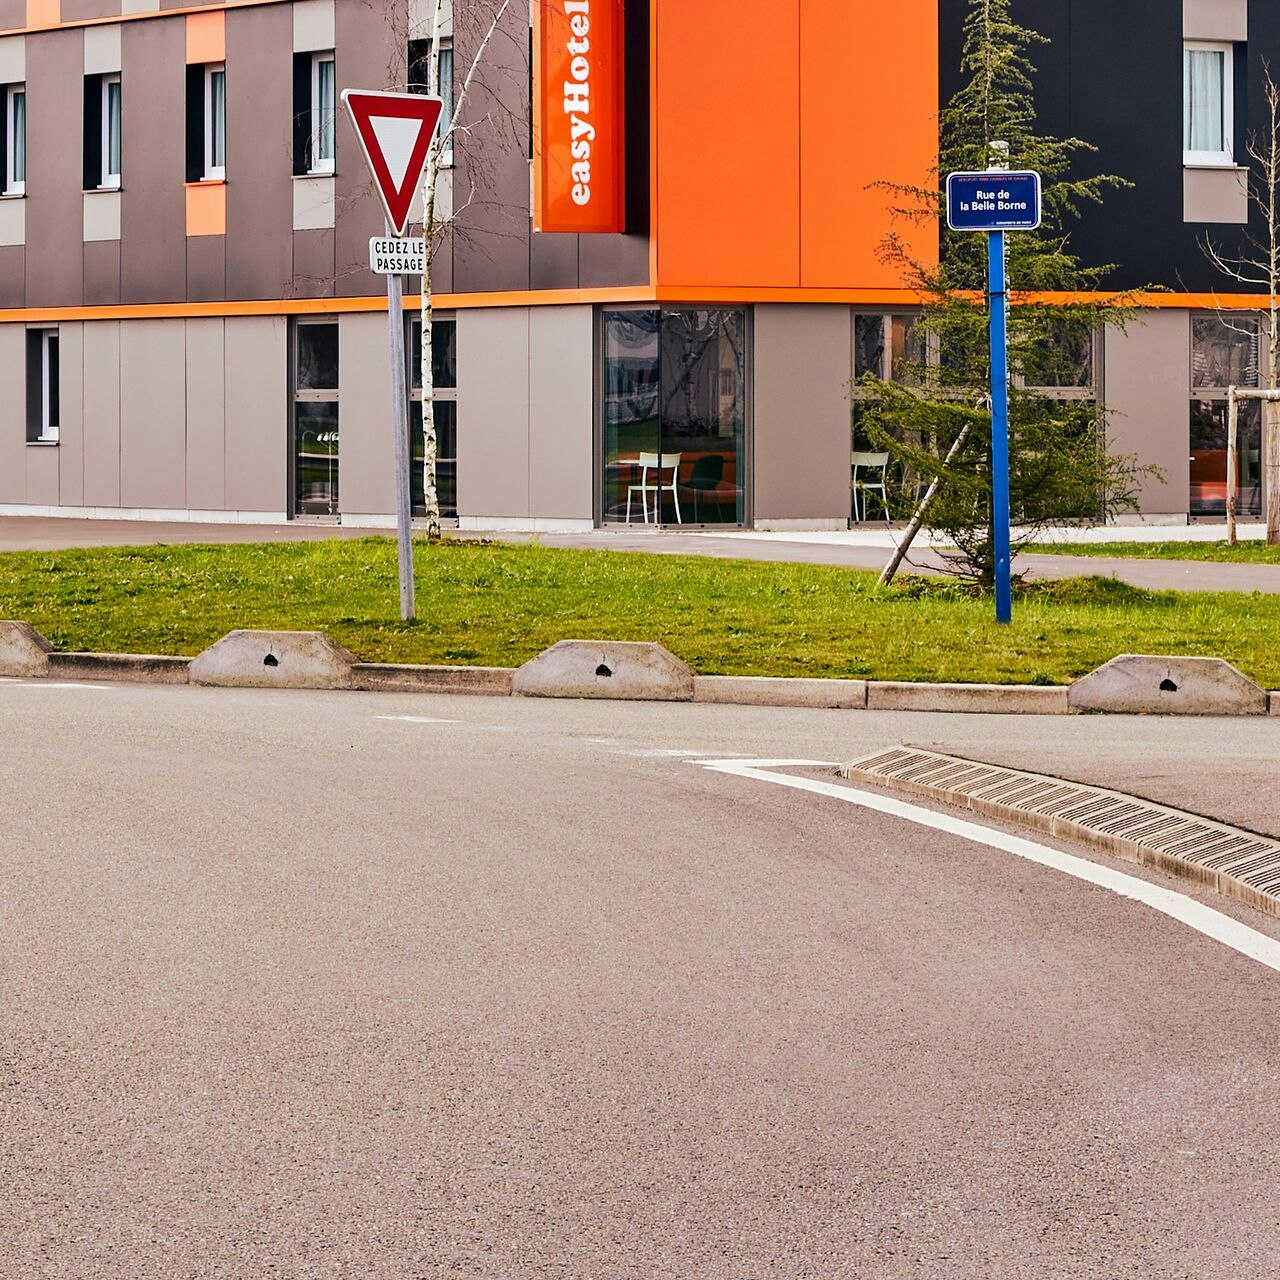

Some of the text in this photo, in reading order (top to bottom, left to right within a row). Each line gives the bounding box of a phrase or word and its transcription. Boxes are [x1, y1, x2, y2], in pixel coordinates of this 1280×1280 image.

[563, 0, 596, 206] easyHotel
[976, 189, 1010, 200] Rue de
[960, 200, 1027, 211] la Belle Borne
[375, 241, 424, 255] CEDEZ LE
[376, 258, 423, 271] PASSAGE
